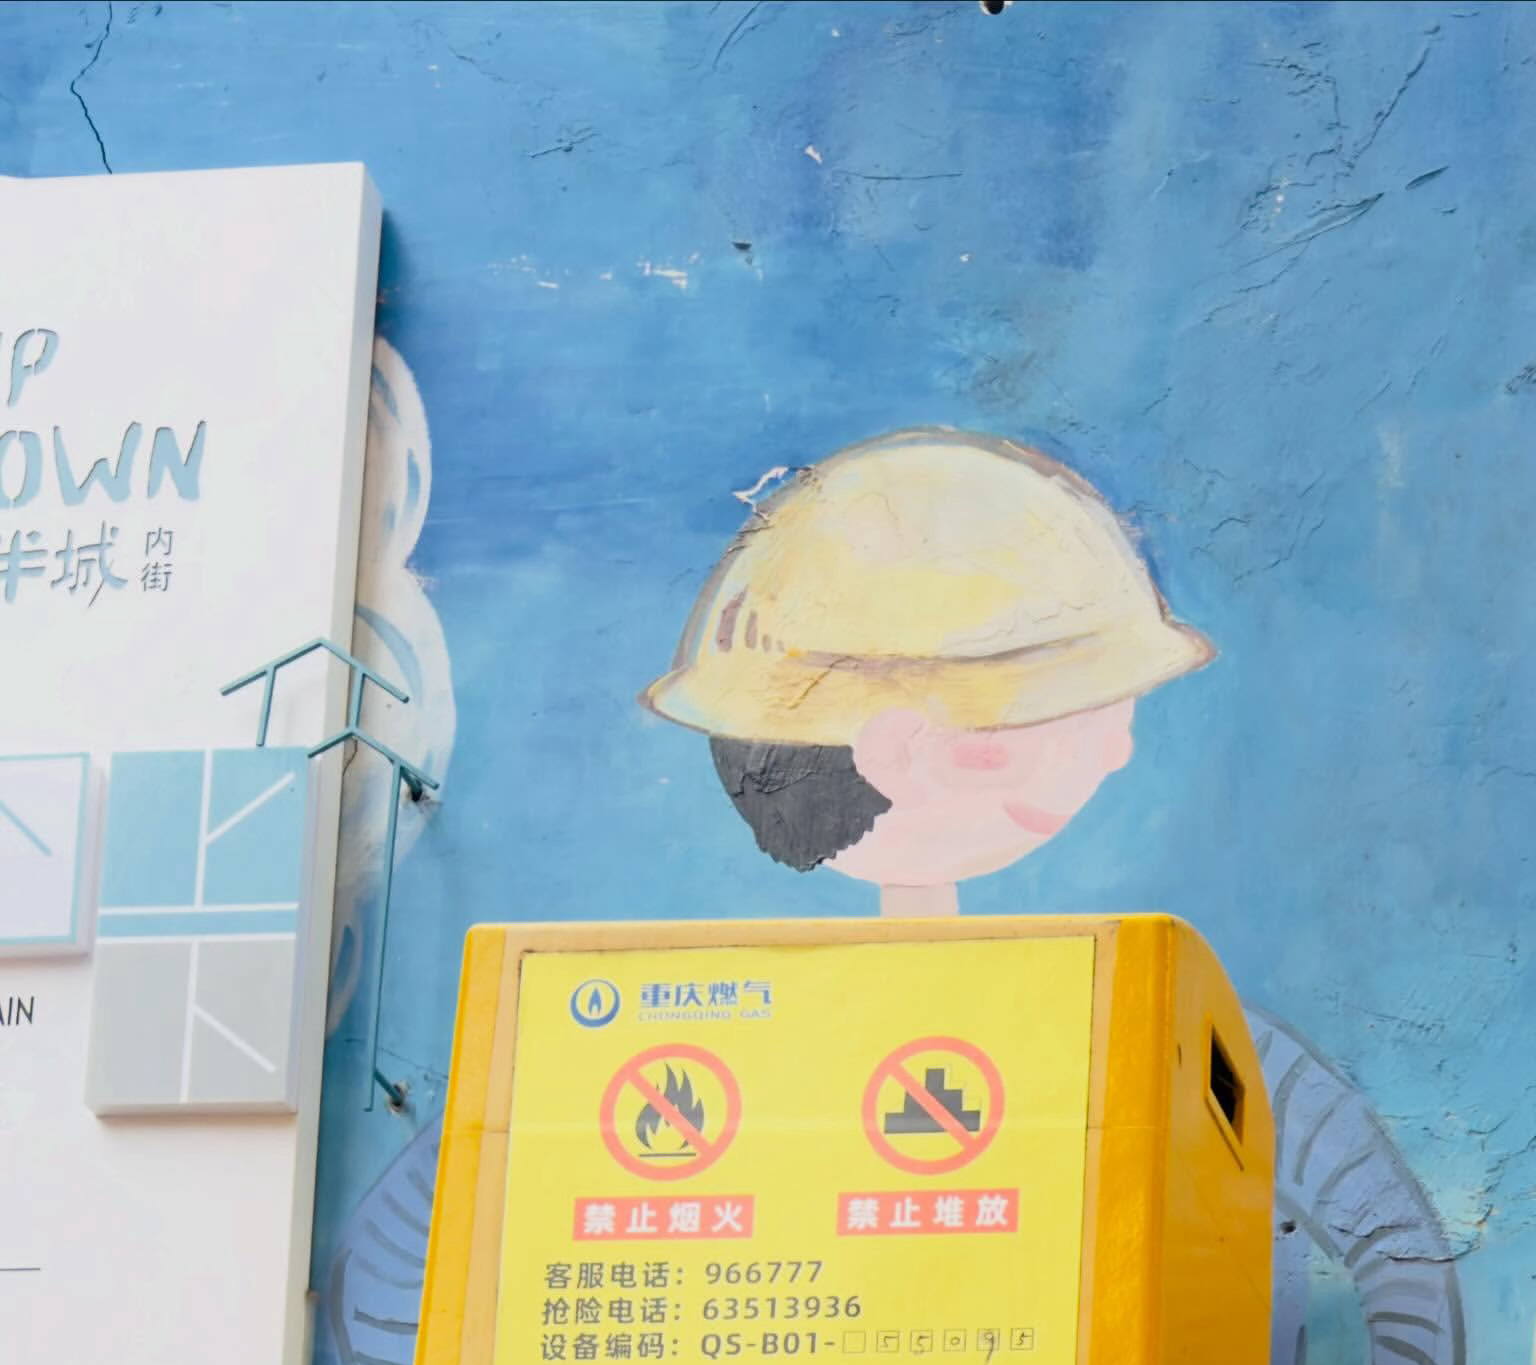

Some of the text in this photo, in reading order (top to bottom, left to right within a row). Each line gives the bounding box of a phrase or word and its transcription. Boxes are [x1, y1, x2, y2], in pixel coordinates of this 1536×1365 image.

[0, 329, 59, 406] P
[140, 527, 174, 592] 内街
[641, 980, 772, 1007] 重庆燃气
[739, 1009, 771, 1020] GAS
[583, 1201, 744, 1235] 禁止烟火
[847, 1194, 1009, 1230] 禁止堆放
[705, 1260, 824, 1285] 966777
[703, 1295, 862, 1321] 63513936
